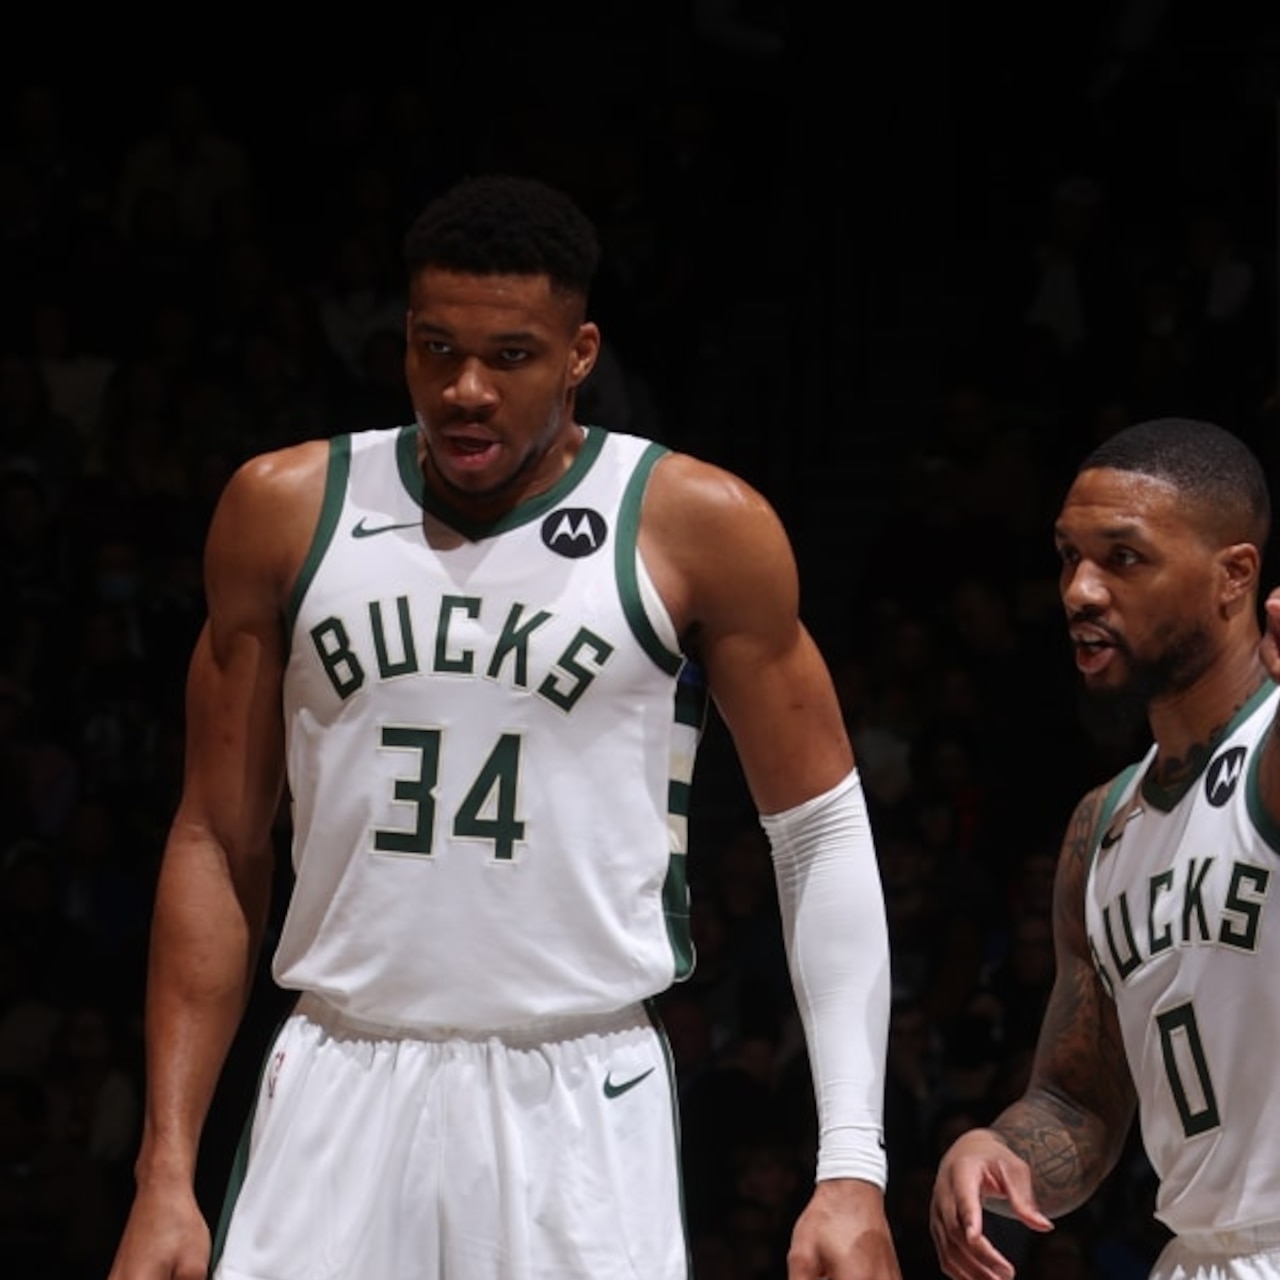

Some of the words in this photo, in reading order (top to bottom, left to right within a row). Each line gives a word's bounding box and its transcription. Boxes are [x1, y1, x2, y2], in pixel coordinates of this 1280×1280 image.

[309, 594, 615, 714] BUCKS
[370, 724, 527, 864] 34
[1154, 999, 1221, 1140] 0
